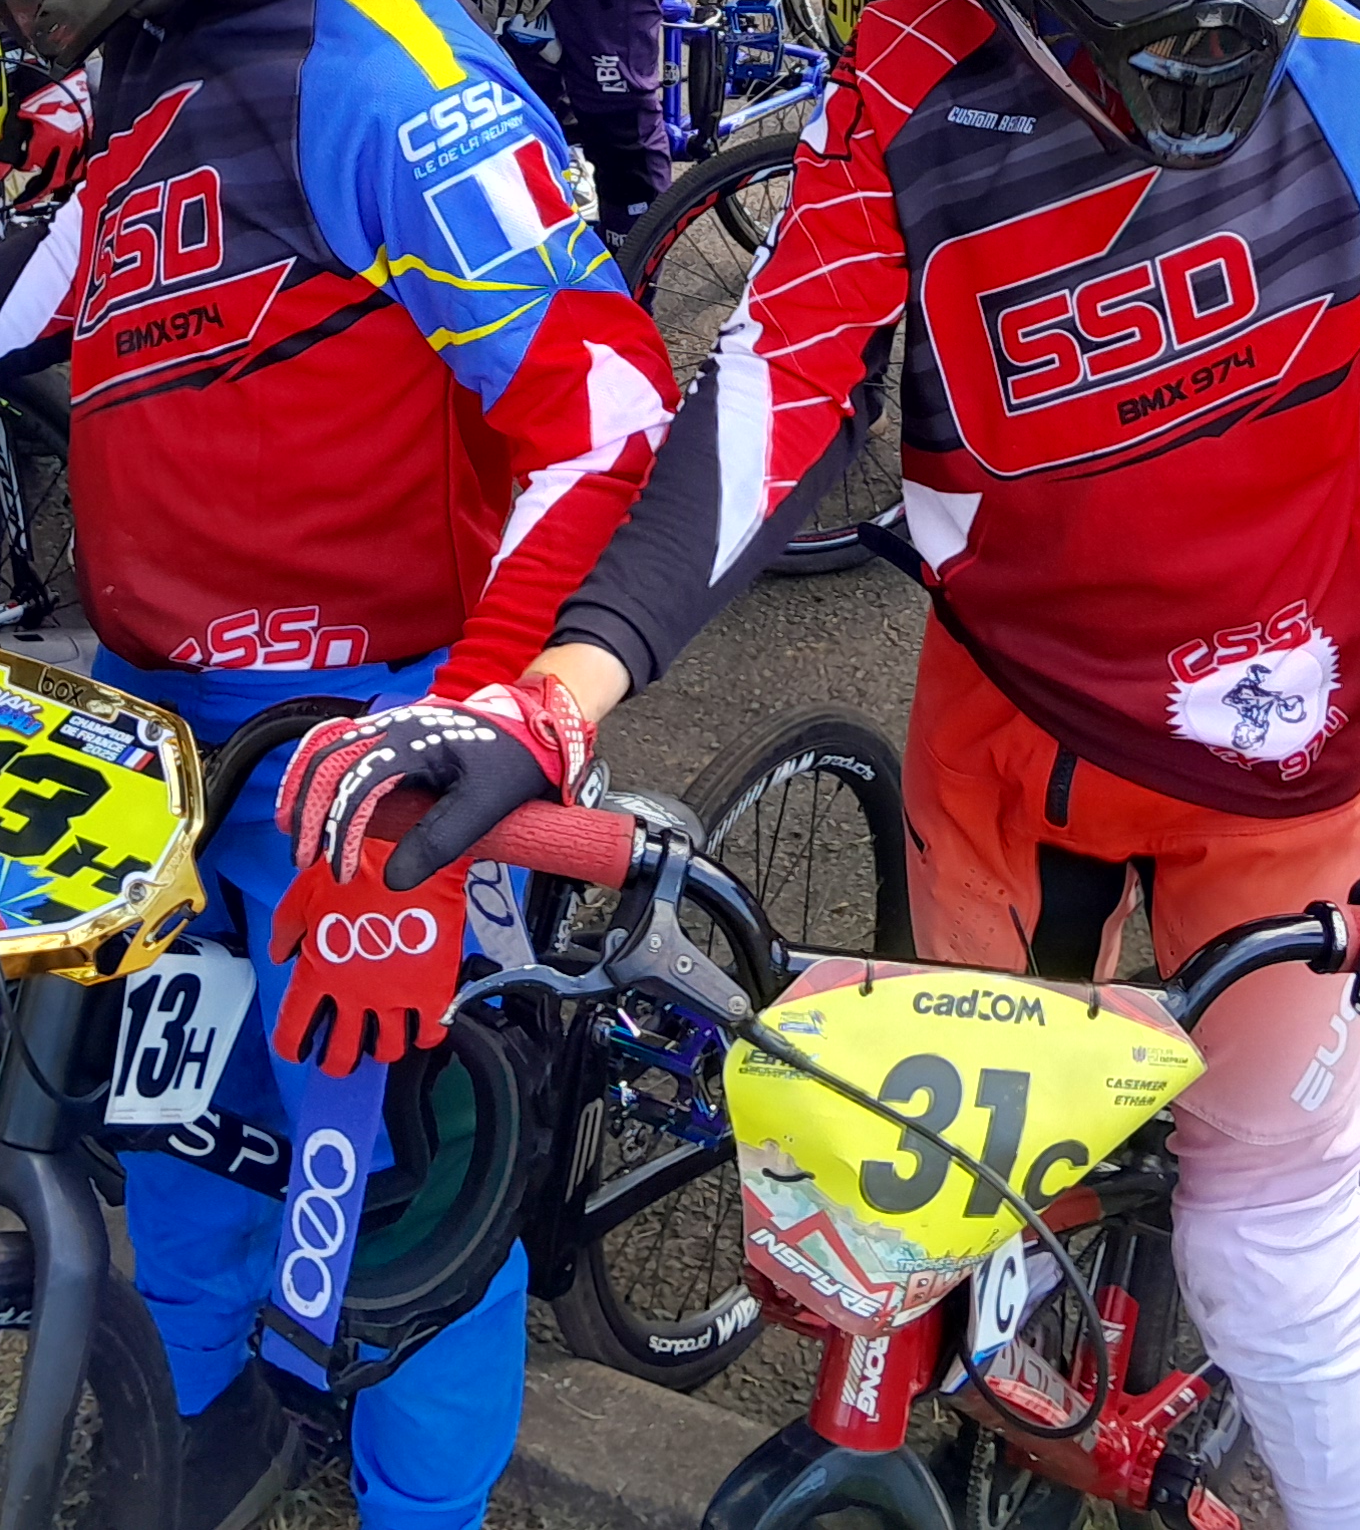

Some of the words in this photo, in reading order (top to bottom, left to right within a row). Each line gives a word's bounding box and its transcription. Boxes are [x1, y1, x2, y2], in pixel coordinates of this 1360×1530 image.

[436, 148, 458, 172] DE
[115, 313, 174, 359] BMX
[170, 301, 226, 343] 974
[1118, 377, 1187, 428] BMX
[1192, 344, 1257, 394] 974
[36, 667, 87, 708] box
[59, 722, 78, 737] DE
[78, 726, 127, 755] FRANCE
[68, 714, 135, 744] CHAMPION
[114, 971, 215, 1101] 13H
[858, 1052, 1092, 1219] 31C
[747, 1227, 886, 1320] INSPYRE
